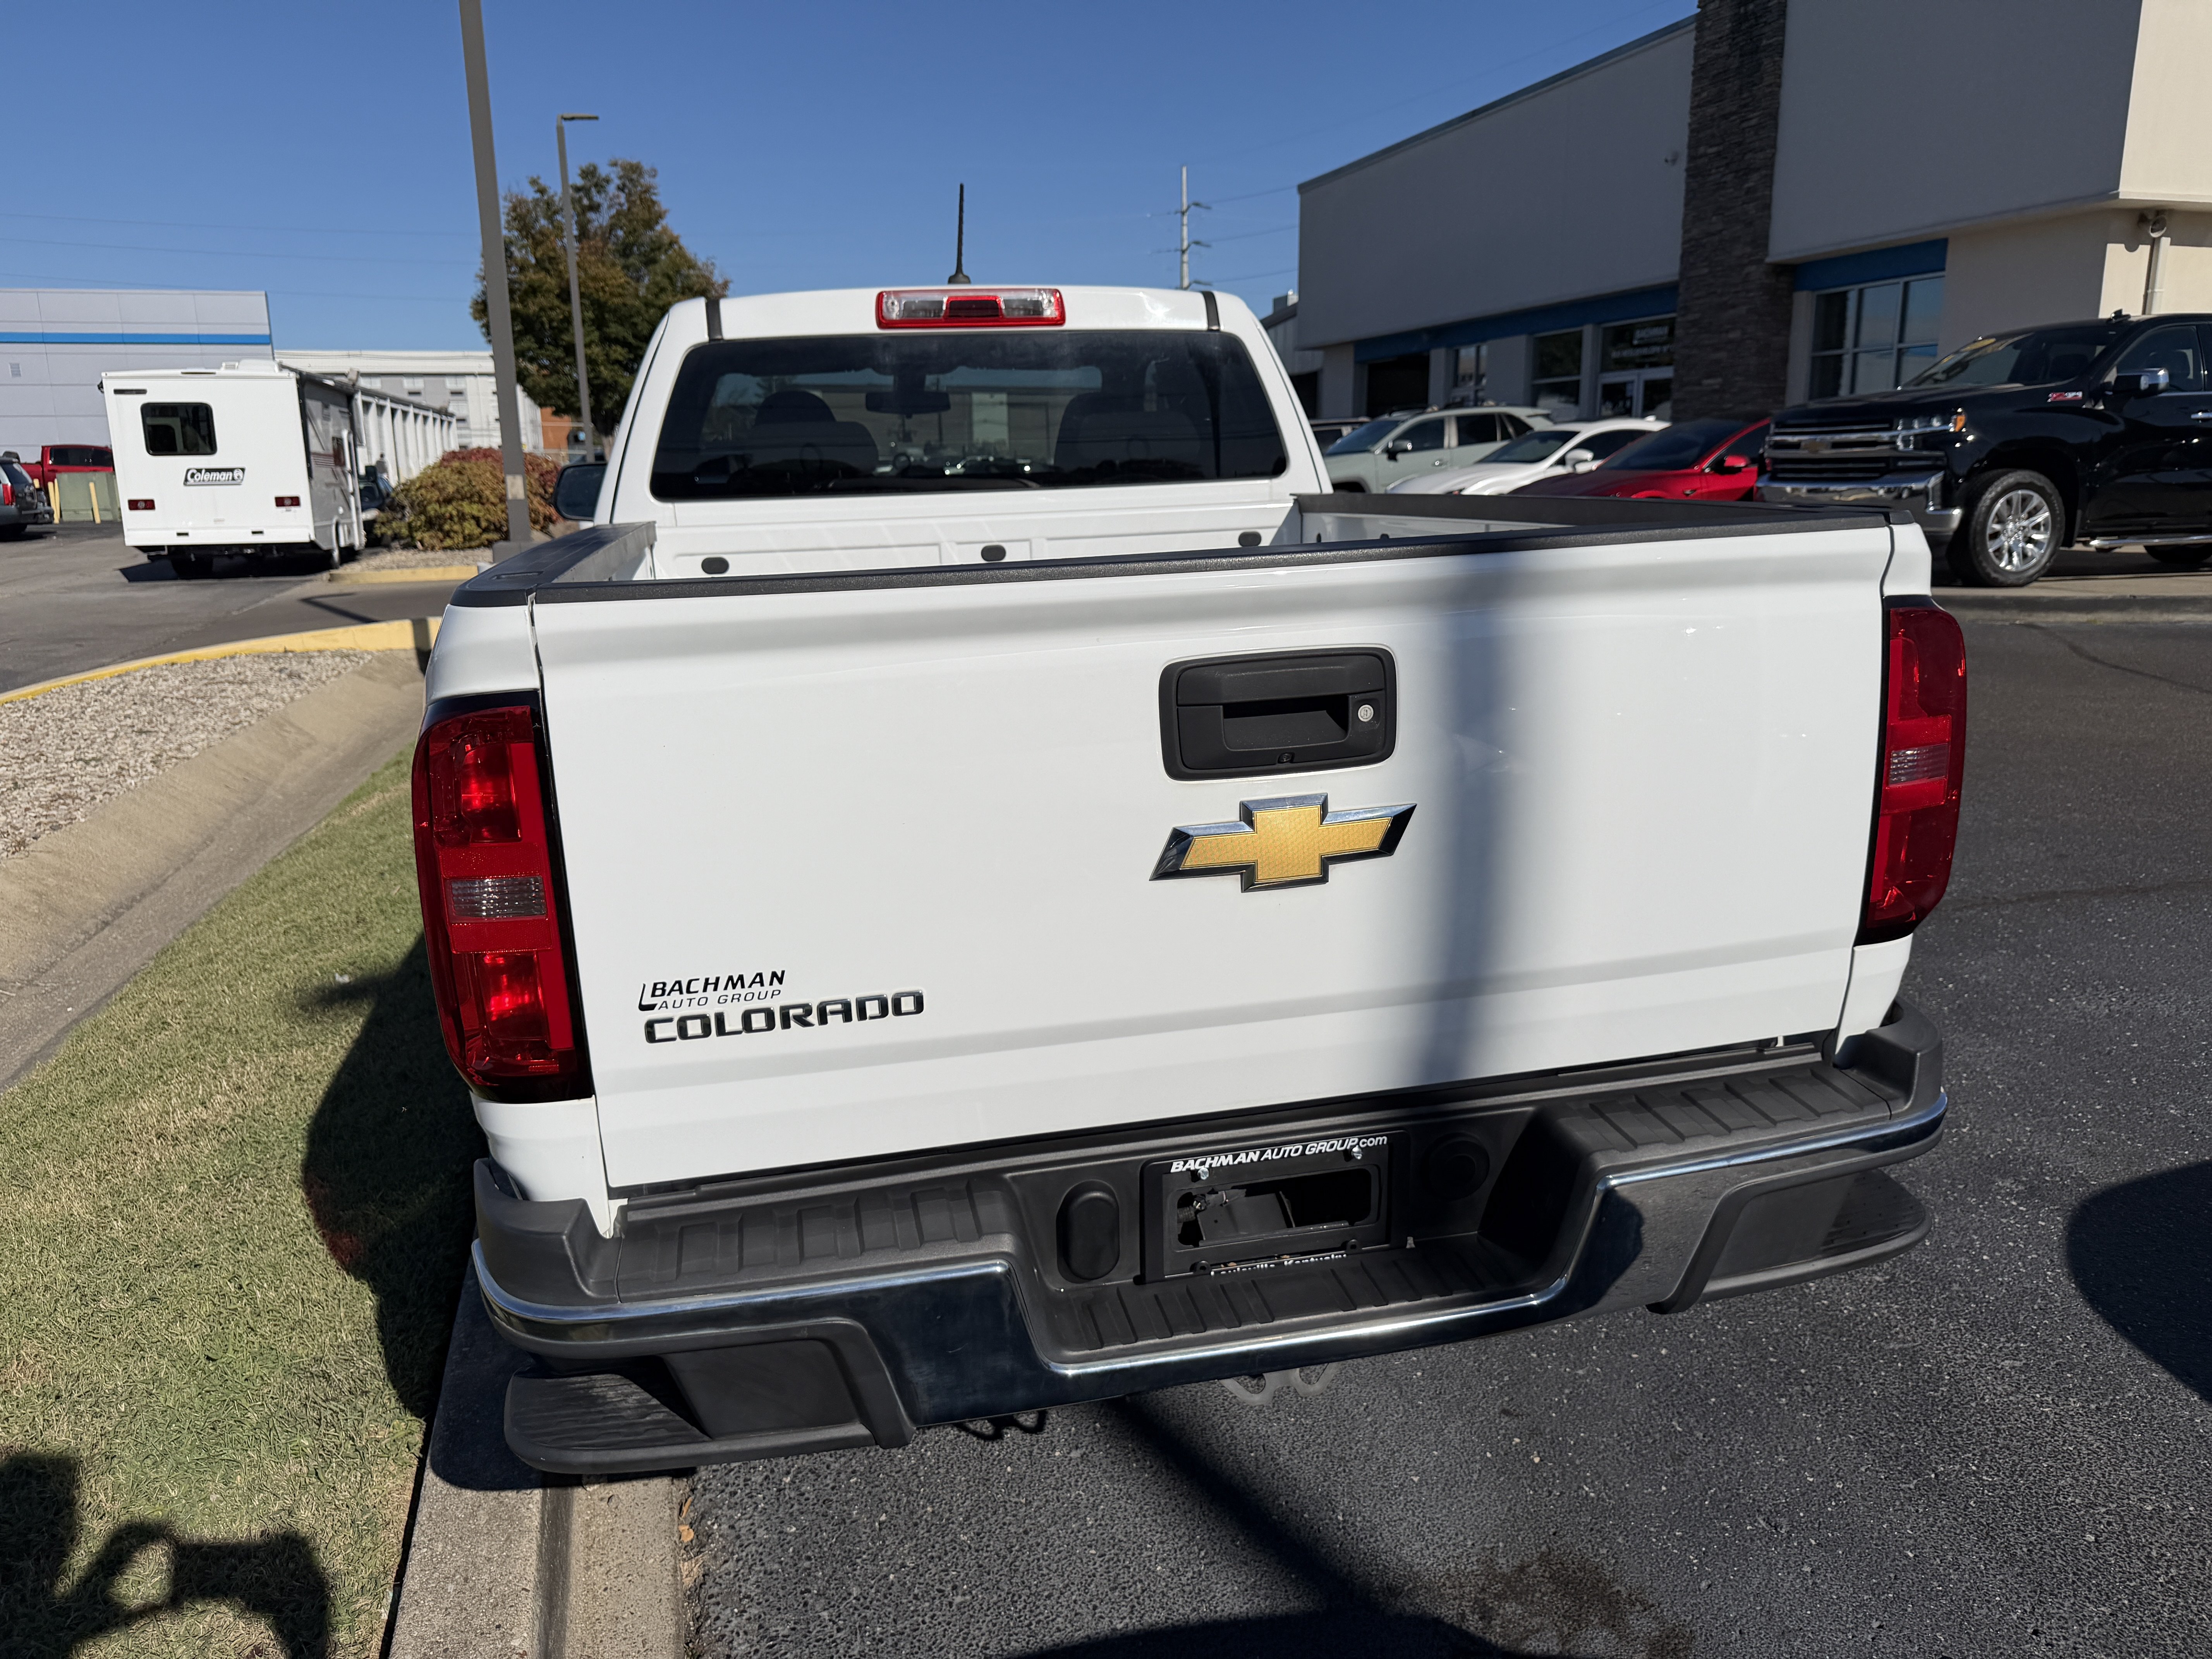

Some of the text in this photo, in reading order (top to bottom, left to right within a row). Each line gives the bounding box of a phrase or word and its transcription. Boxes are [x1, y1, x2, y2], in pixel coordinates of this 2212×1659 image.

[187, 468, 233, 483] Coleman
[650, 970, 785, 998] BACHMAN
[658, 989, 782, 1010] AUTO GROUP
[644, 989, 925, 1044] COLORADO
[1170, 1150, 1260, 1173] BACHMAN
[1260, 1145, 1303, 1161] AUTO
